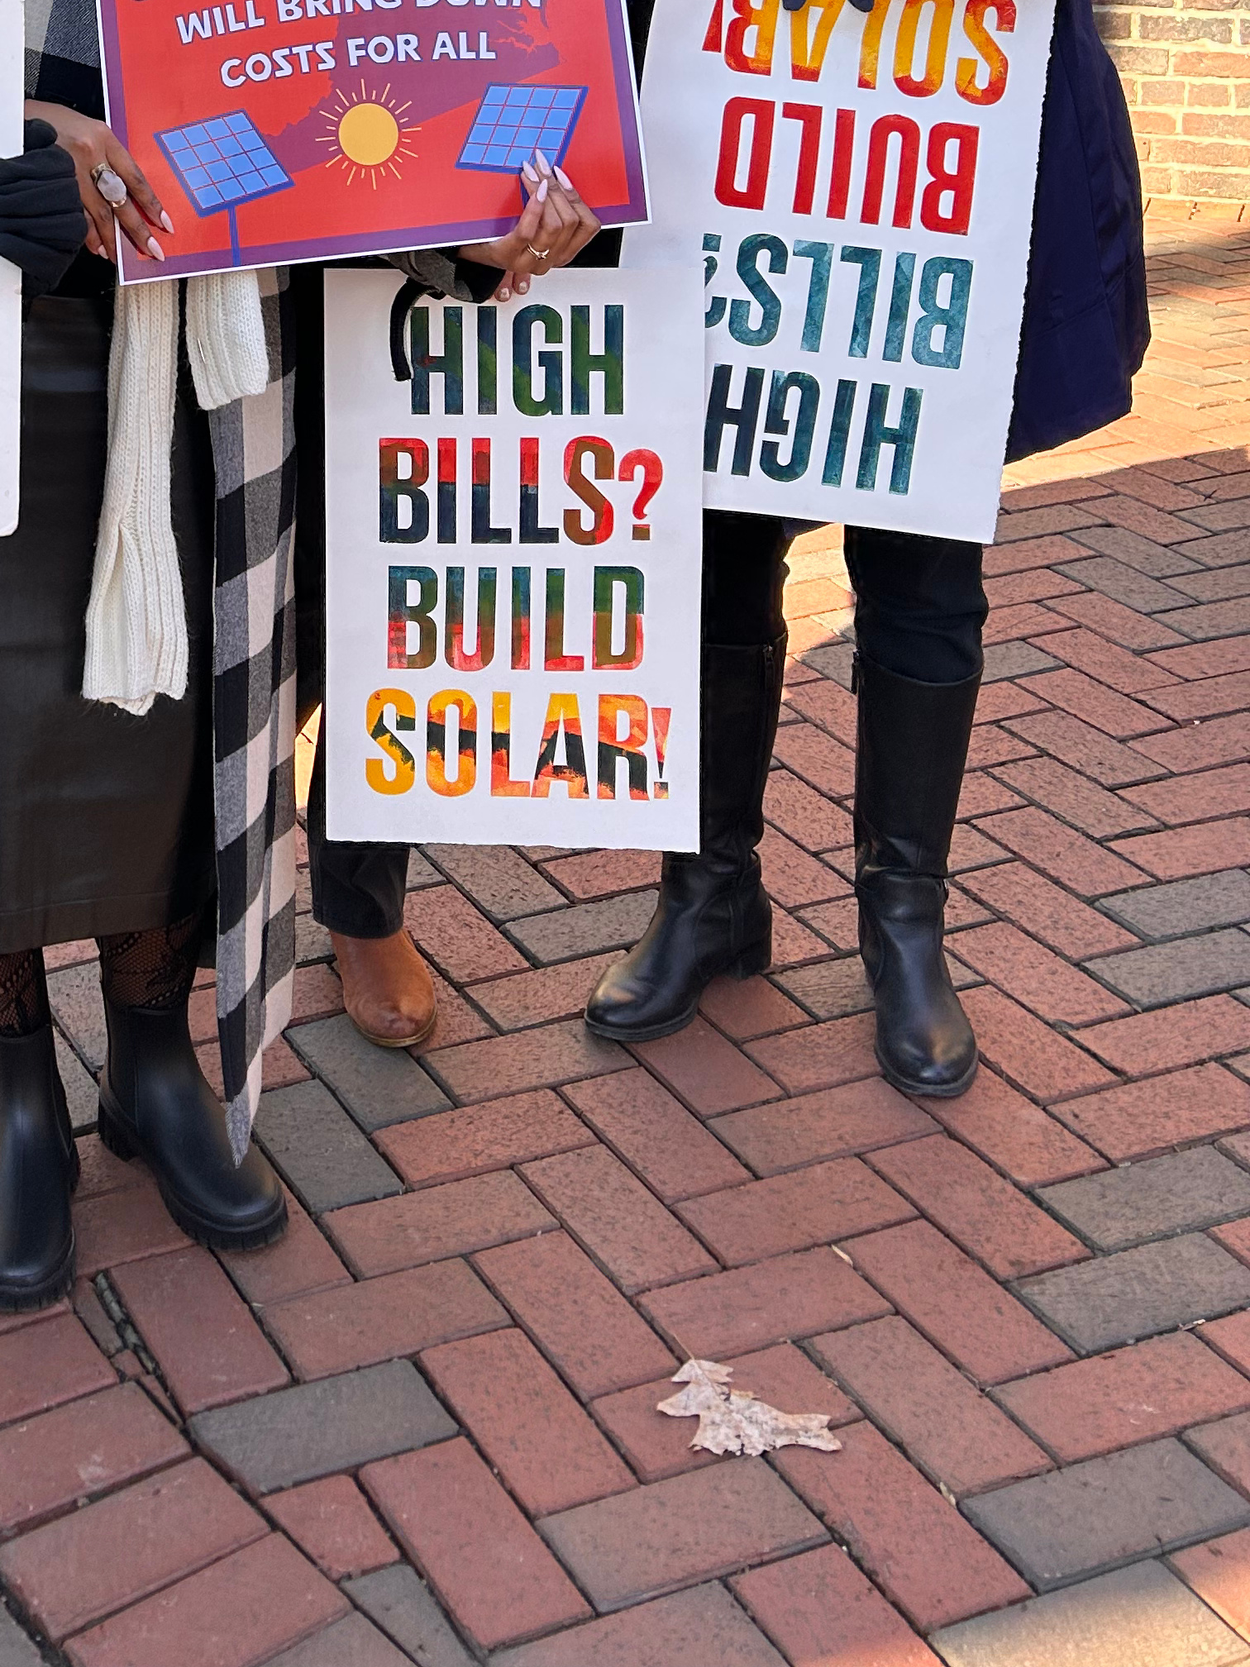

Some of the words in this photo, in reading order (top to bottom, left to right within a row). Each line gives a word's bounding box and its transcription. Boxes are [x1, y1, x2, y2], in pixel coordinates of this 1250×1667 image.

[175, 0, 265, 45] WILL
[220, 41, 336, 88] COSTS
[347, 34, 422, 67] FOR
[432, 32, 497, 60] ALL
[714, 97, 981, 236] BUILD
[411, 303, 624, 417] HIGH
[704, 364, 923, 495] HIGH
[378, 436, 664, 545] BILLS?
[387, 566, 645, 671] BUILD
[365, 688, 672, 800] SOLAR!
